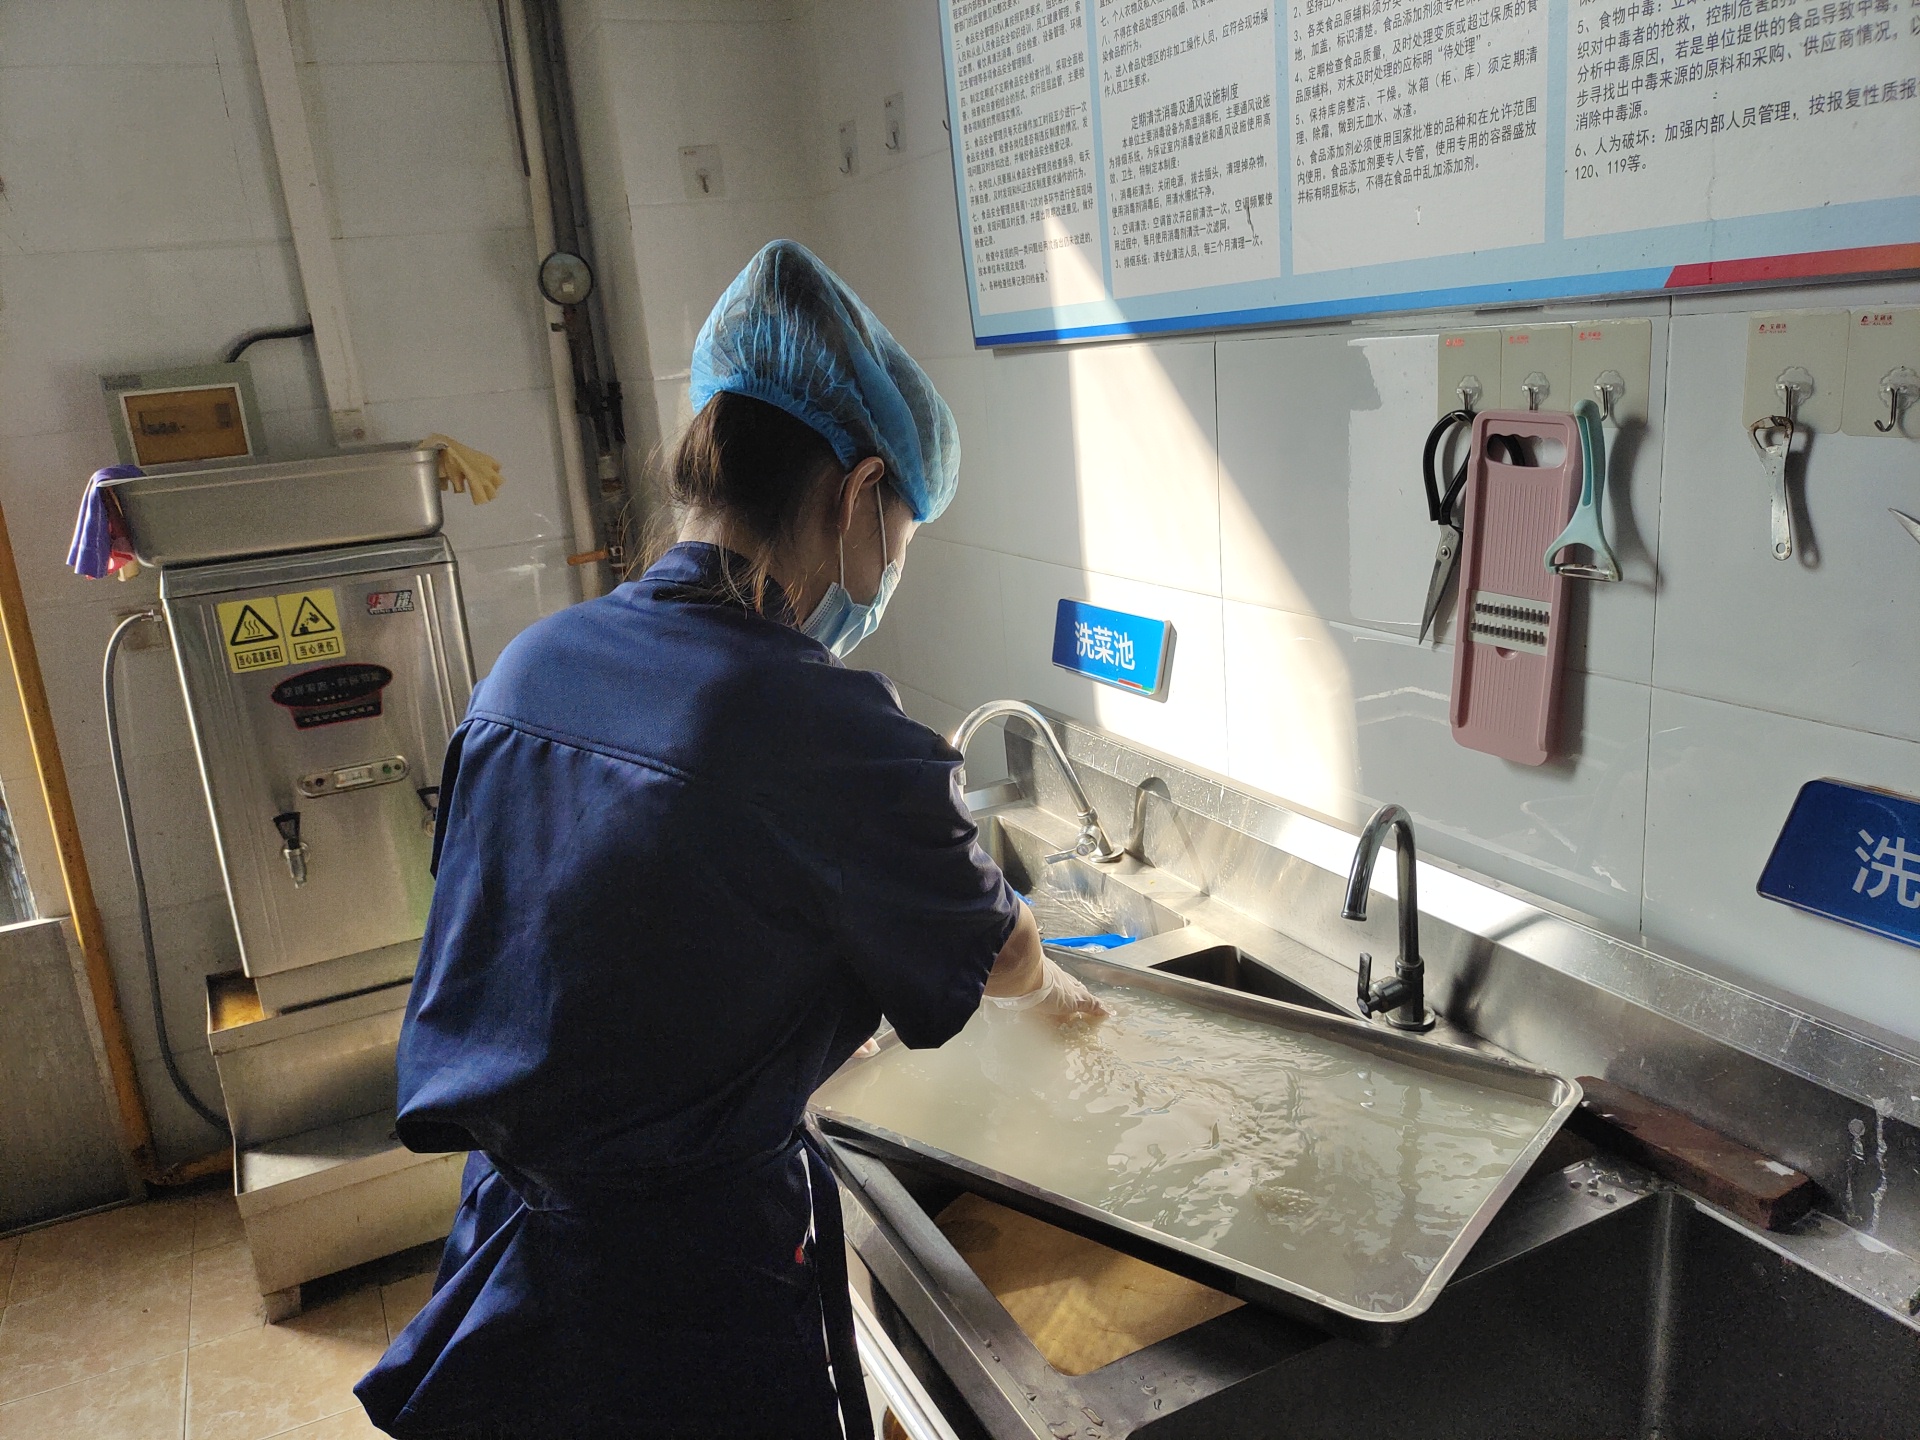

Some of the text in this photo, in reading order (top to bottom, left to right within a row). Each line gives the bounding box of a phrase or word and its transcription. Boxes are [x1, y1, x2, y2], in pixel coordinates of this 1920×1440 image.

[1103, 40, 1142, 64] 染食品的行为。
[1104, 8, 1269, 82] 九、进入食品处理区的非加工操作人员，应符合现场操
[1295, 0, 1538, 83] 4、定期检查食品质量，及时处理变质或超过保质的食
[1577, 0, 1920, 84] 分析中毒原因，若是单位提供的食品导致中毒，
[1104, 73, 1150, 98] 作人员卫生要求。
[1131, 83, 1239, 130] 定期清洗消毒及通风设施制度
[1296, 46, 1538, 125] 5、保持库房整洁、干燥。冰箱（柜、库）须定期清
[1122, 93, 1271, 149] 本单位主要消毒设备为高温消毒柜，主要通风设施
[1296, 103, 1417, 146] 理、除霜，做到无血水、冰渣。
[1297, 96, 1537, 167] 6、食品添加剂必须使用国家批准的品种和在允许范围
[1575, 100, 1648, 131] 消除中毒源。
[1575, 78, 1920, 158] 6、人为破坏：加强内部人员管理，按报复性质报
[1109, 112, 1271, 169] 为排烟系统。为保证室内消毒设施和通风设施使用高
[1297, 119, 1537, 186] 内使用。食品添加剂要专人专管，使用专用的容器盛放
[1110, 157, 1180, 185] 效、卫生，特制定本制度：
[1298, 154, 1479, 205] 并标有明显标志，不得在食品中乱加添加剂。
[1575, 154, 1648, 181] 120、119等。
[1113, 192, 1273, 236] 2、空调清洗：空调首次开启前清洗一次，空调频繁使
[1114, 219, 1230, 252] 用过程中，每月使用消毒剂清洗一次滤网。
[1115, 234, 1264, 270] 3、排烟系统：请专业清洁人员，每三个月清理一次。
[300, 642, 334, 656] 当心烫伤
[1075, 621, 1135, 670] 洗菜池
[1852, 829, 1920, 908] 洗
